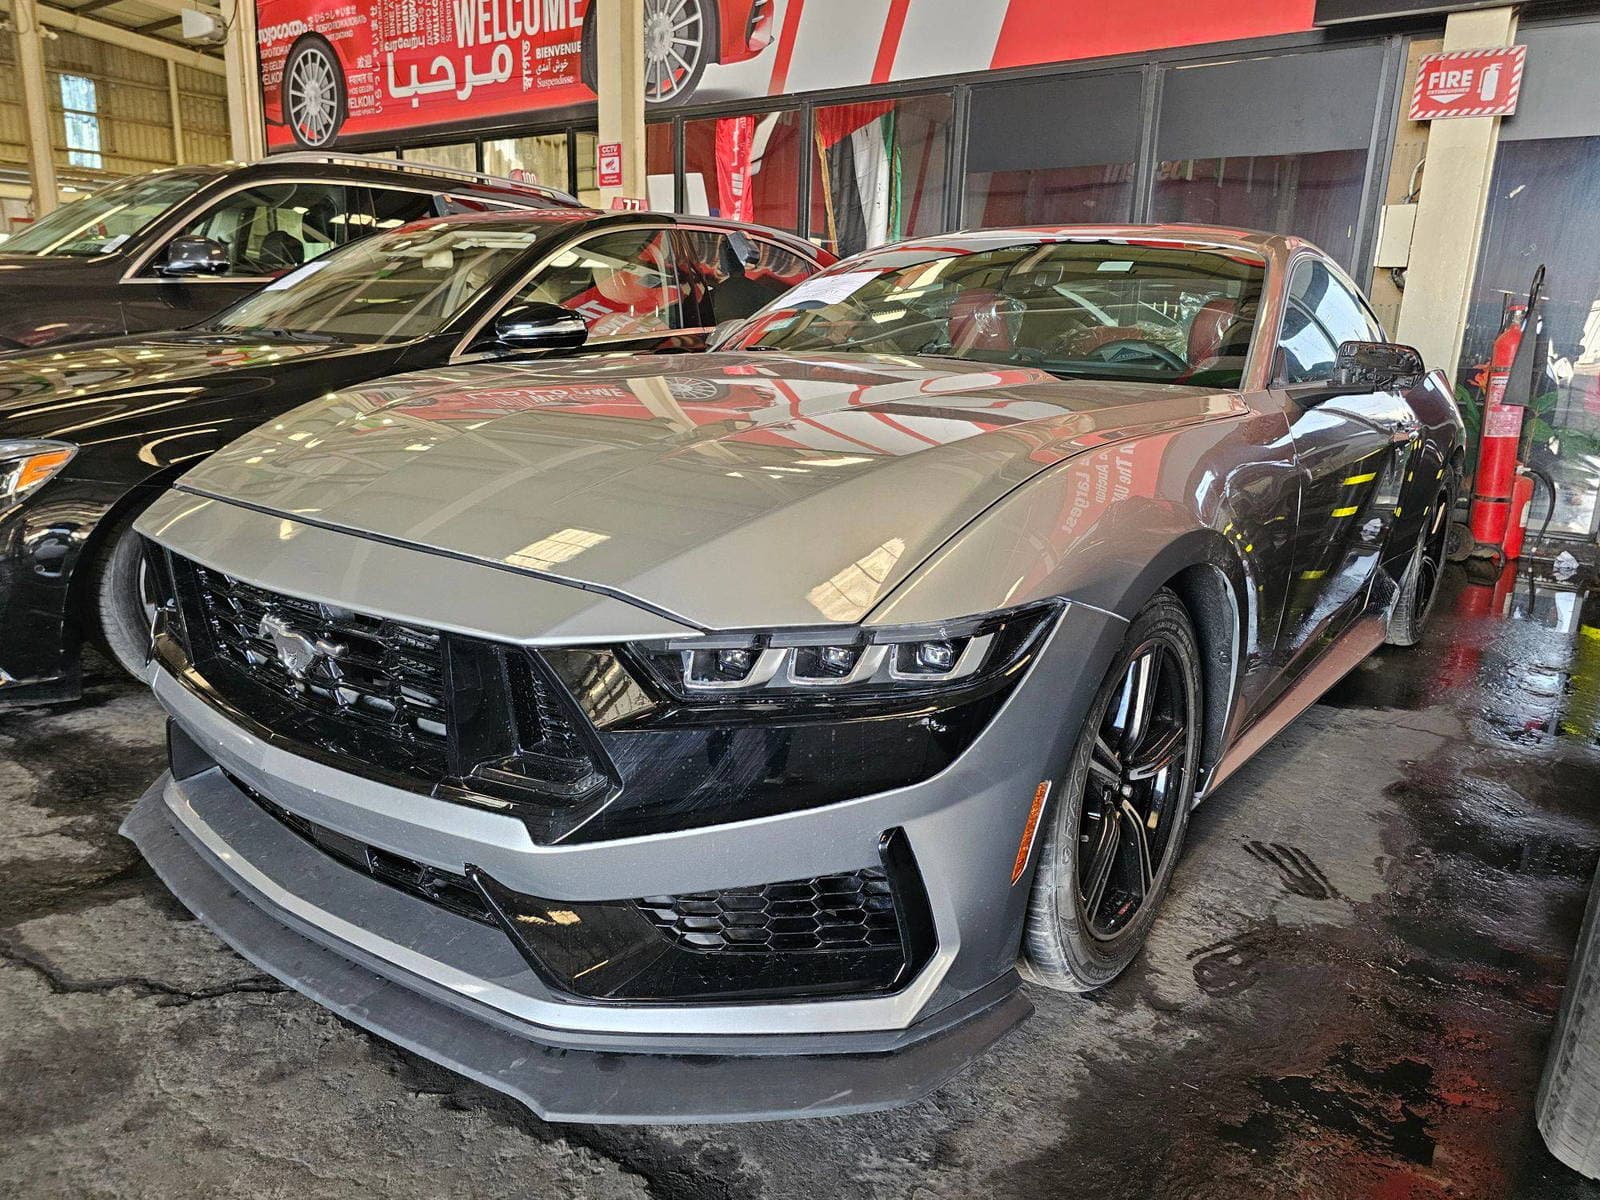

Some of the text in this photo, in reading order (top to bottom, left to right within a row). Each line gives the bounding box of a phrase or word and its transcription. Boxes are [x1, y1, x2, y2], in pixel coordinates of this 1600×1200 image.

[453, 0, 584, 48] WELCOME
[535, 41, 582, 59] BIENVENUE
[387, 44, 514, 109] مرحبا
[1428, 69, 1474, 90] FIRE
[601, 145, 617, 154] CCTV
